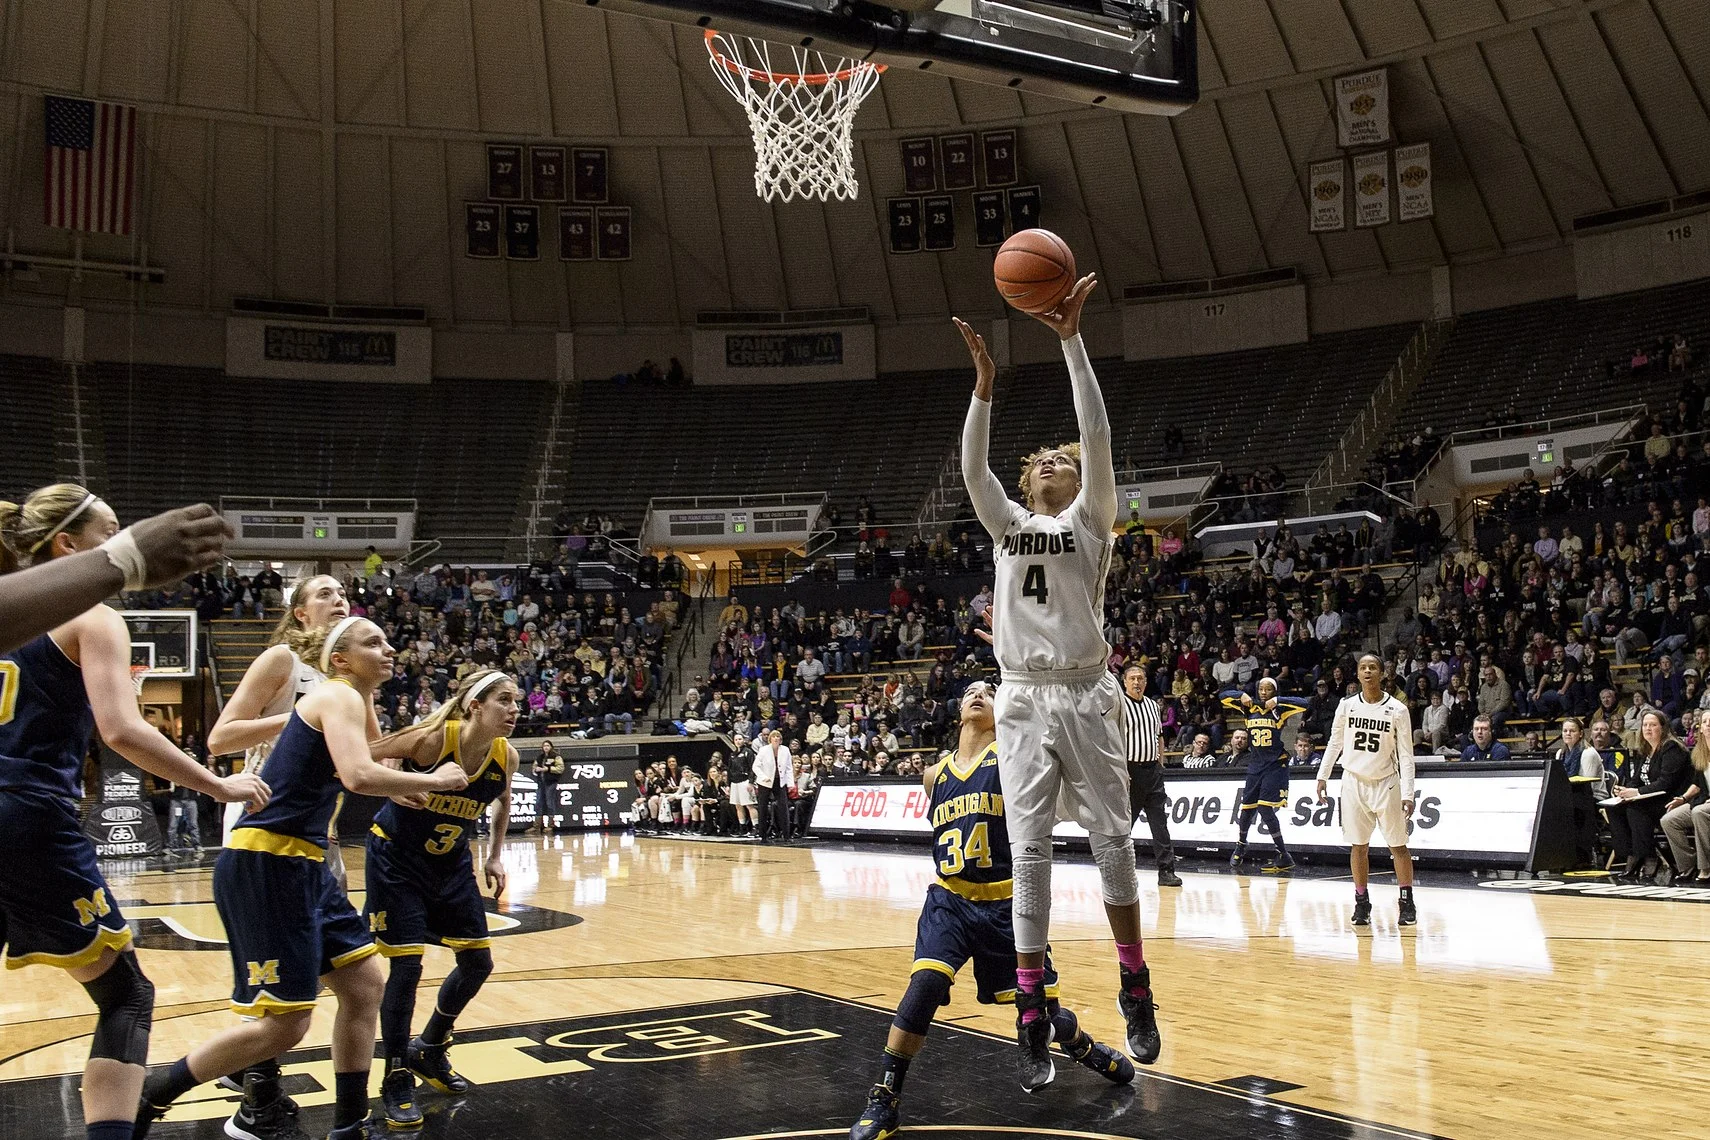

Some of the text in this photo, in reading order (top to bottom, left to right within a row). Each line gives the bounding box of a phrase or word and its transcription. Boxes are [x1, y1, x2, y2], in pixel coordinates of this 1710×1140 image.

[1341, 74, 1382, 88] PURDUE
[952, 152, 966, 164] 22
[994, 148, 1008, 160] 13
[497, 163, 512, 174] 27
[912, 156, 926, 167] 10
[541, 164, 556, 176] 13
[585, 165, 595, 176] 7
[983, 208, 997, 220] 33
[1022, 204, 1030, 216] 4
[898, 215, 912, 226] 23
[934, 213, 946, 224] 25
[475, 220, 491, 232] 23
[514, 222, 530, 234] 37
[569, 224, 584, 234] 43
[607, 224, 622, 235] 42
[1667, 226, 1692, 242] 118
[1204, 304, 1224, 316] 117
[728, 338, 786, 350] PAINT
[728, 350, 786, 364] CREW
[1001, 531, 1076, 556] PURDUE
[1022, 564, 1048, 604] 4
[1348, 717, 1391, 732] PURDUE
[1250, 728, 1272, 747] 32
[1354, 731, 1380, 752] 25
[560, 790, 572, 806] 2
[606, 788, 619, 804] 3
[902, 792, 929, 818] FU
[424, 823, 464, 855] 3
[96, 842, 146, 856] PIONEER
[938, 822, 992, 876] 34
[72, 886, 111, 926] M
[368, 910, 388, 932] M
[246, 959, 281, 986] M
